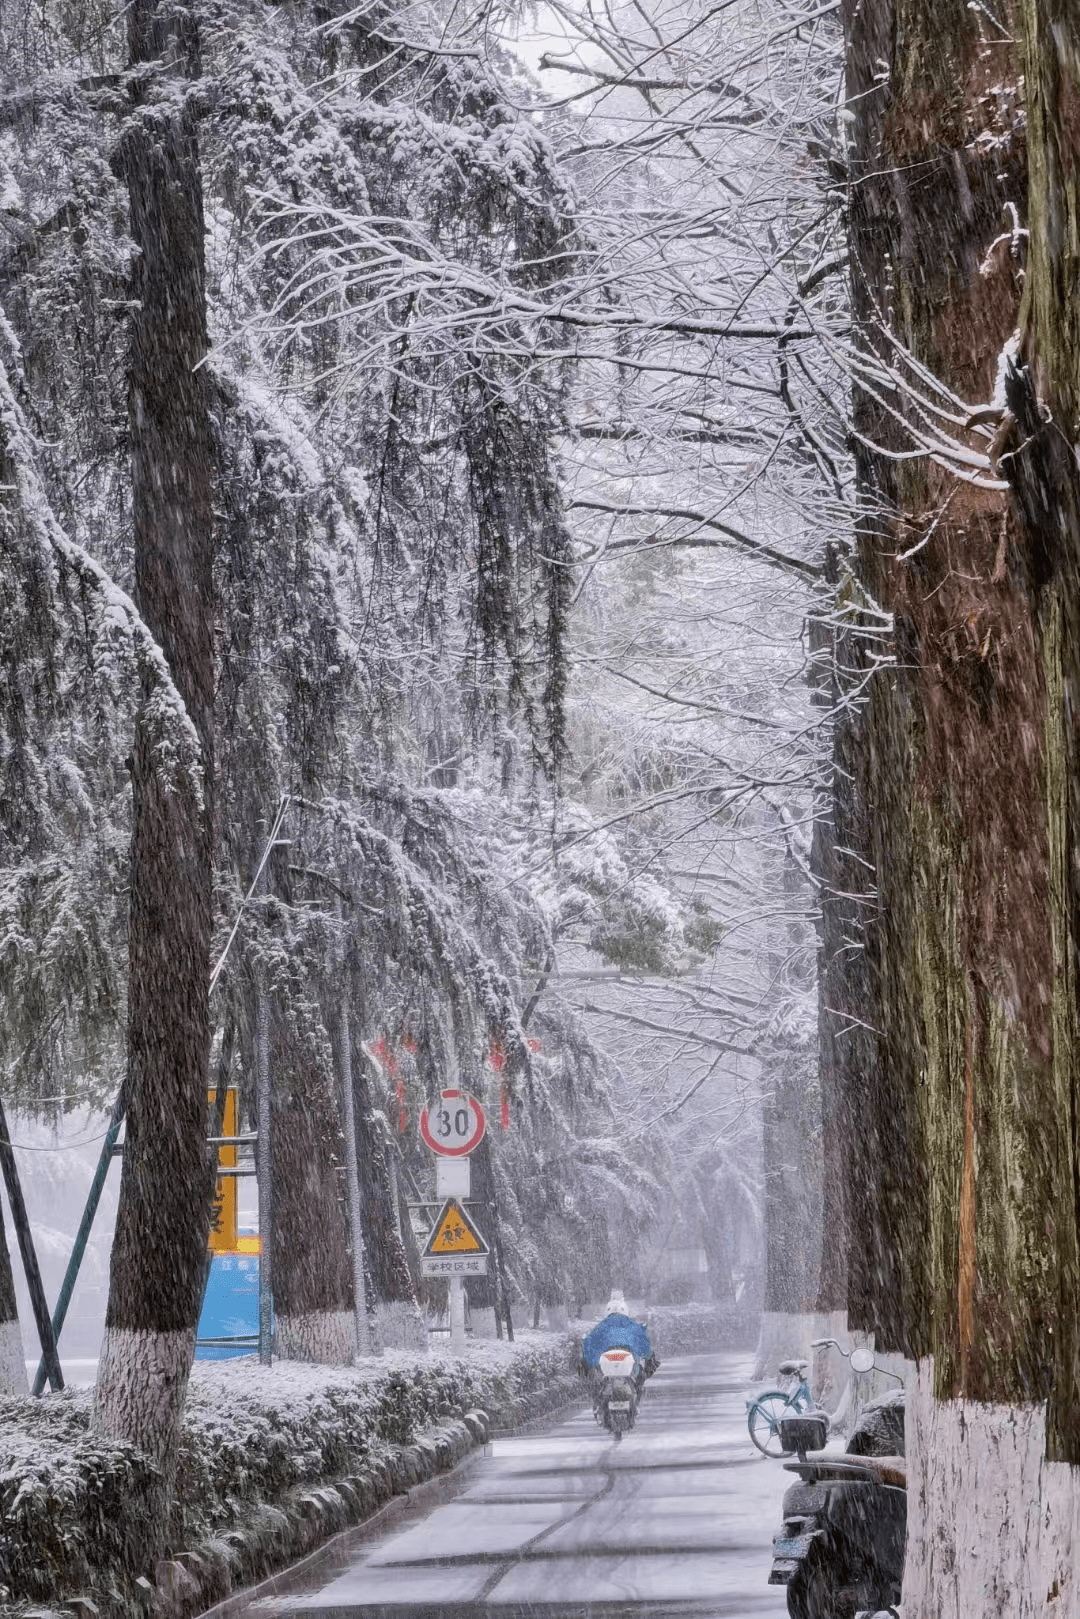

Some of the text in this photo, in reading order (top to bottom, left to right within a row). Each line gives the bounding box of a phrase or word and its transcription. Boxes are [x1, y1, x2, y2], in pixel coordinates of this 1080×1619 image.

[437, 1109, 469, 1137] 30
[426, 1261, 480, 1273] 学校区域
